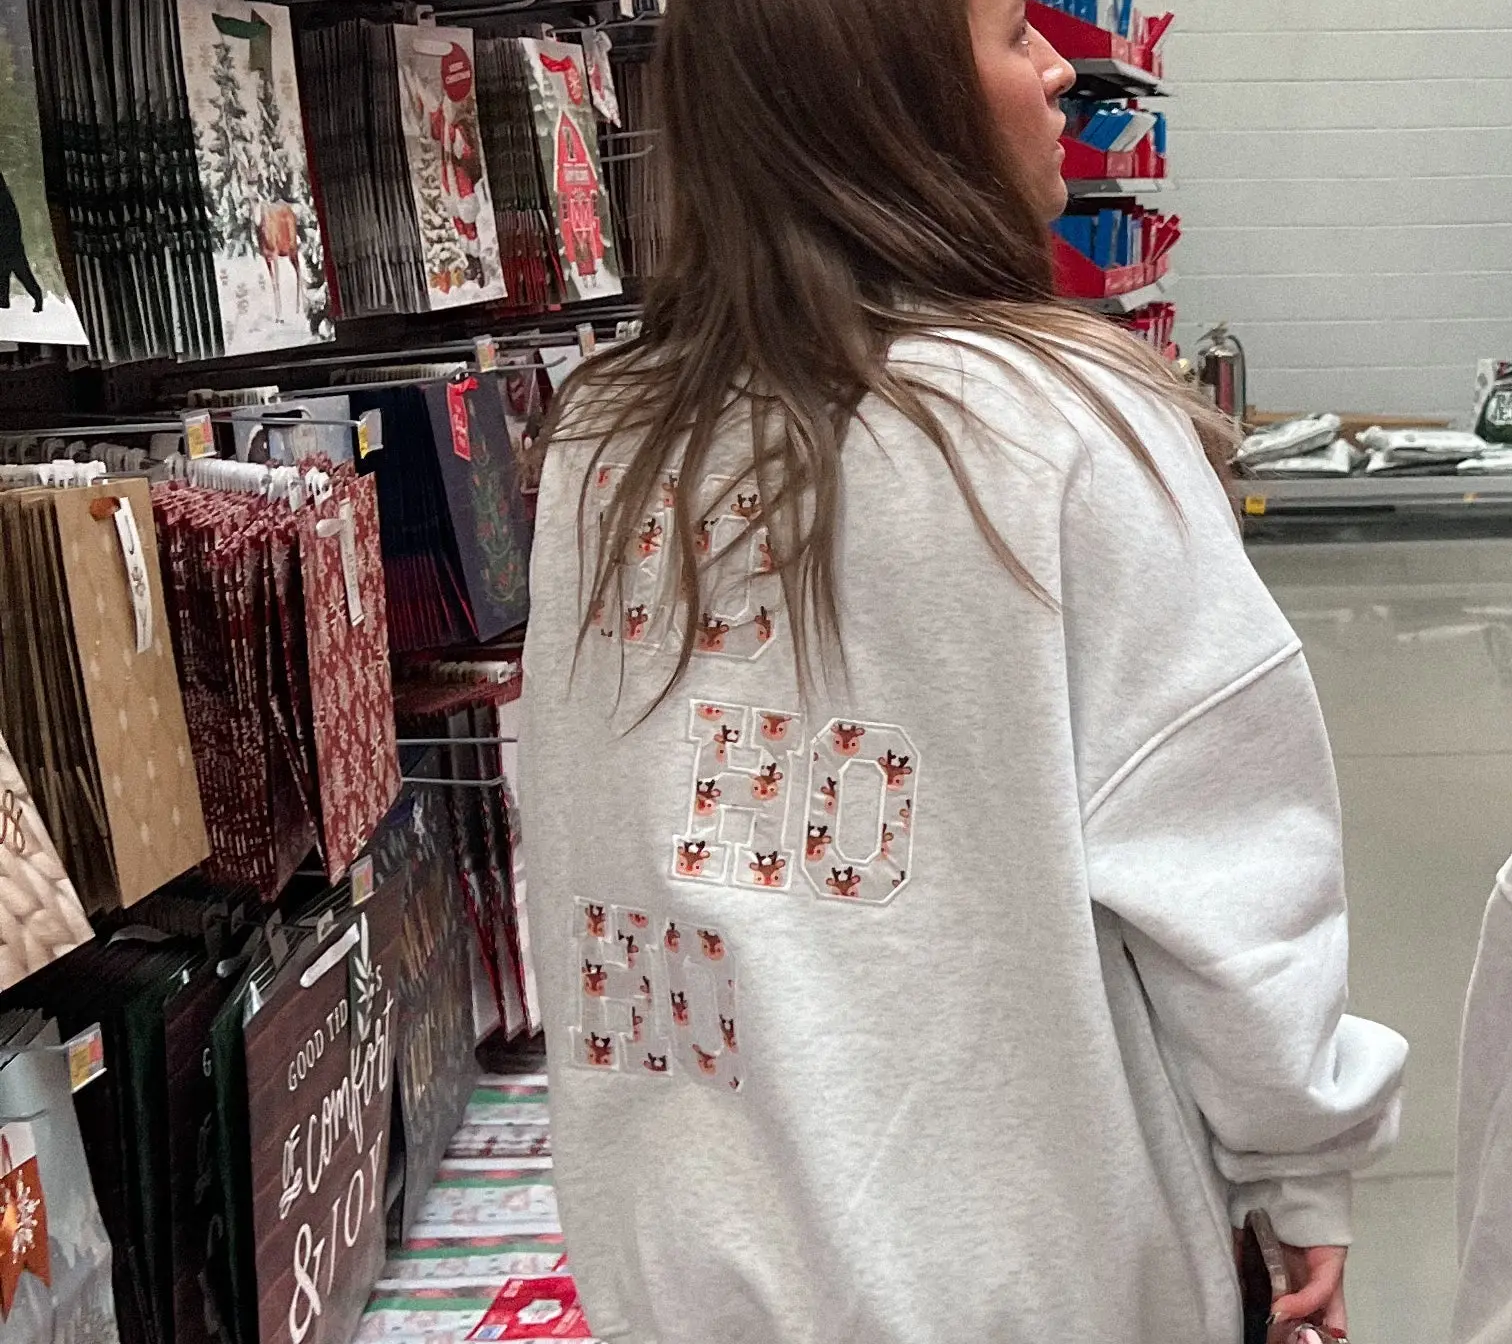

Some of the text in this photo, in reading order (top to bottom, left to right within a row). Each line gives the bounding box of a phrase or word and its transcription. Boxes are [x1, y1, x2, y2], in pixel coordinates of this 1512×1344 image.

[669, 698, 922, 906] HO
[287, 1027, 325, 1093] GOOD
[570, 895, 743, 1092] HO
